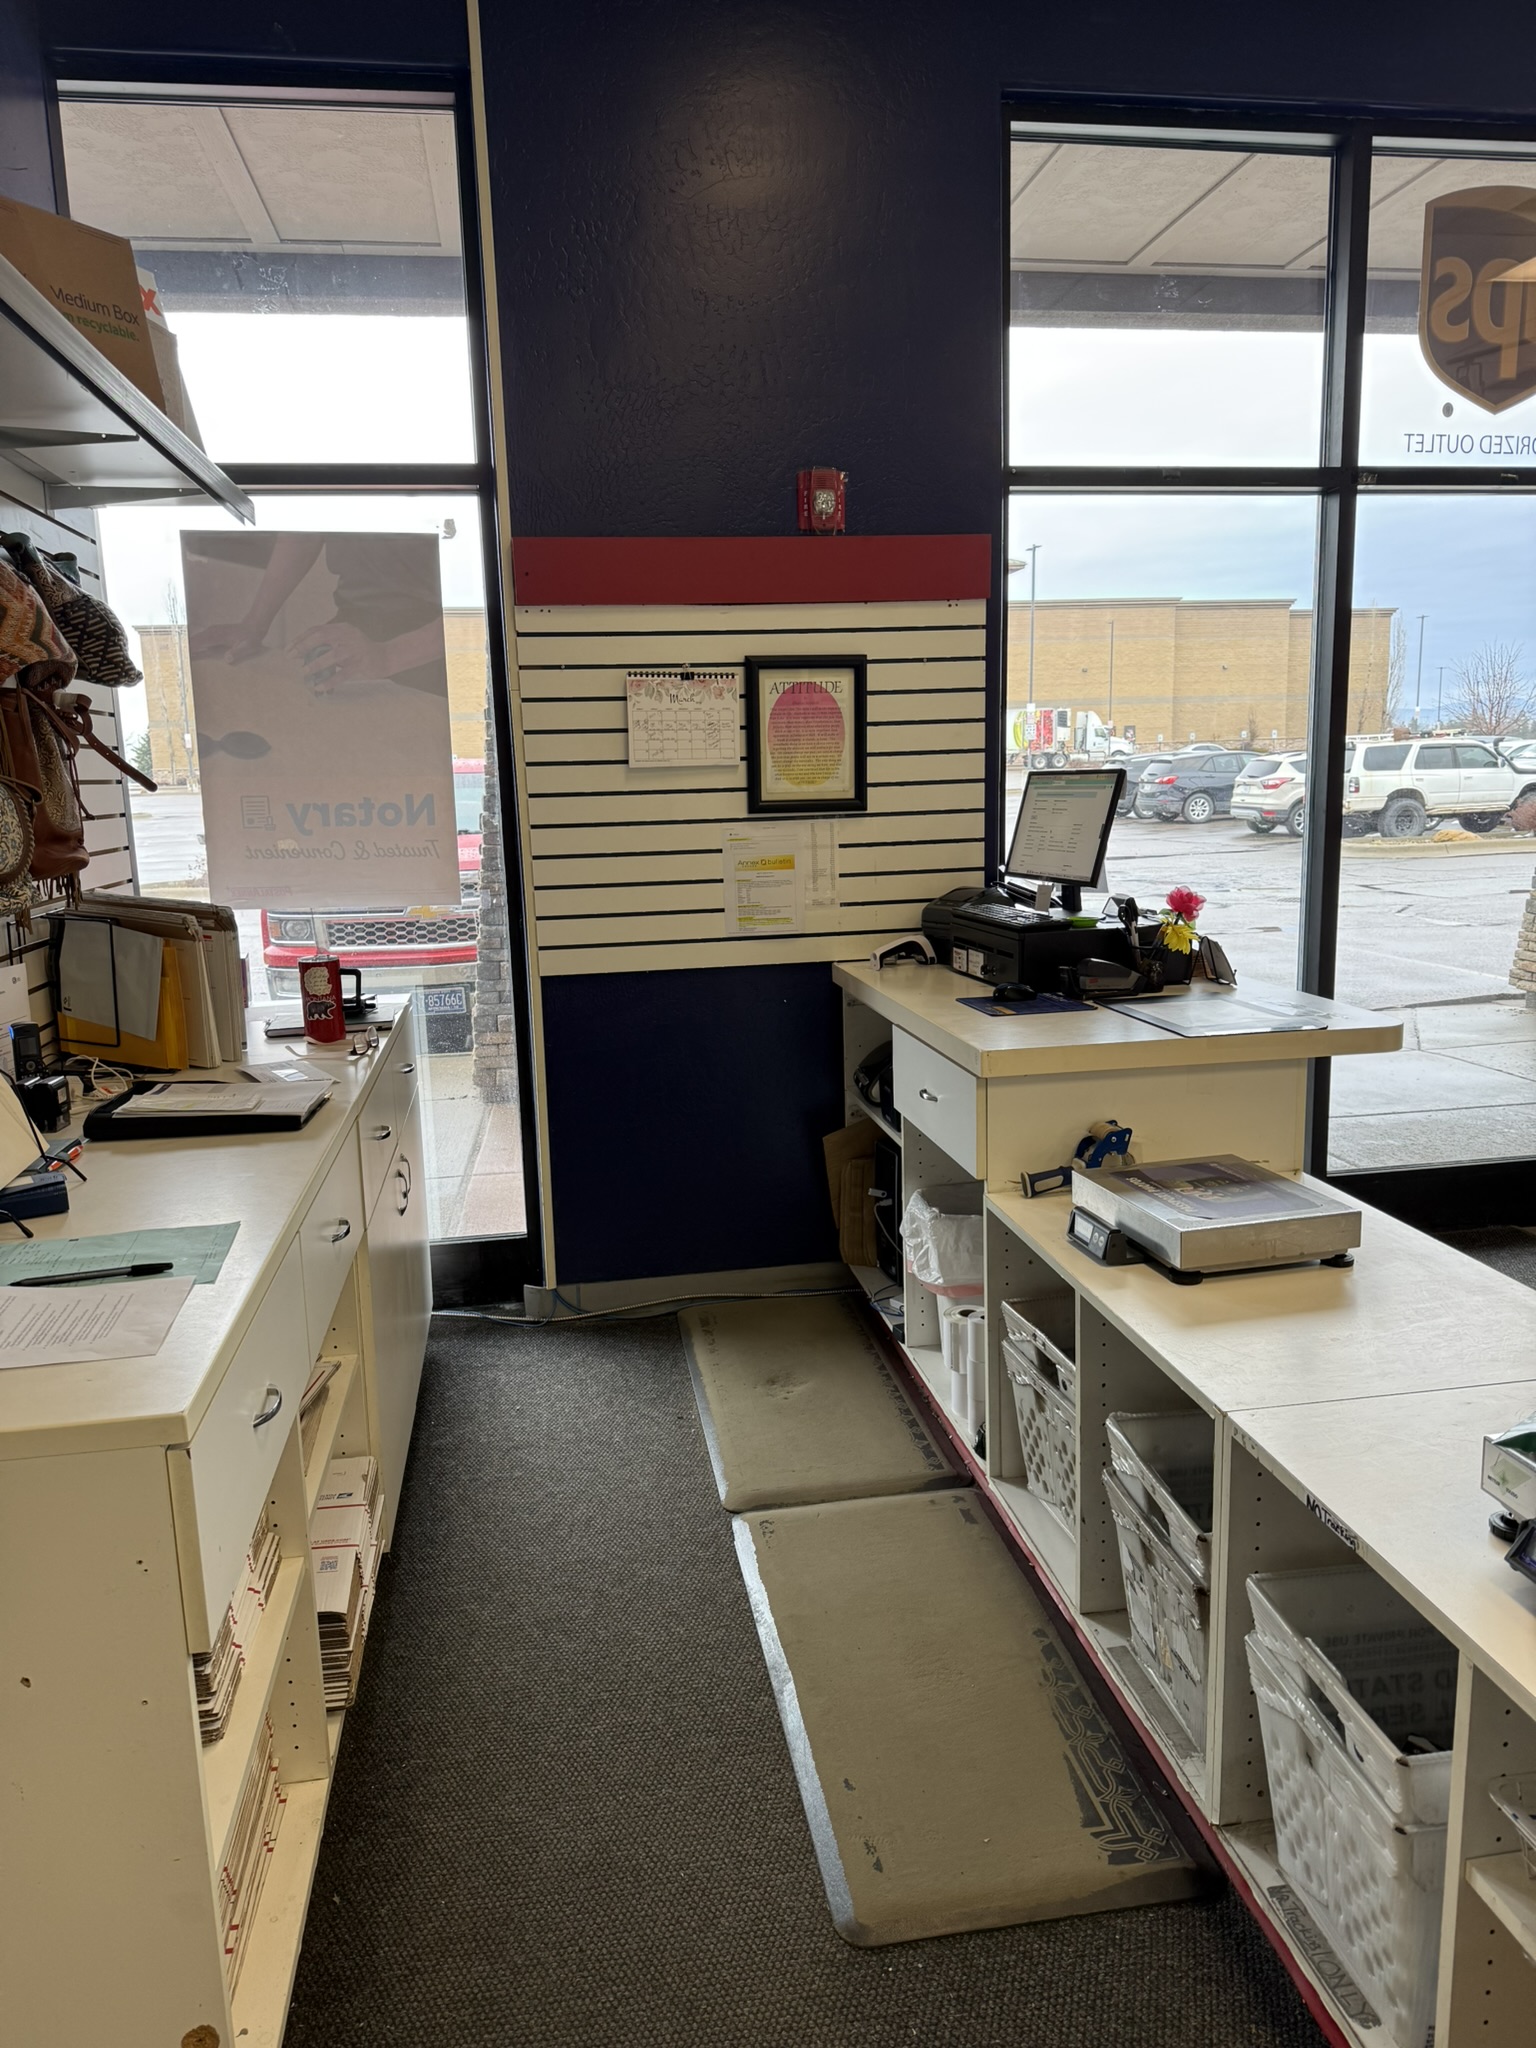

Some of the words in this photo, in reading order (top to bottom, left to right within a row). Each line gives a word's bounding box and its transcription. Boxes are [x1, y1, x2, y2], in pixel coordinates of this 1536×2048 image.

[113, 304, 140, 326] Box
[77, 315, 140, 341] recyclable.
[769, 680, 843, 695] ATTITUDE
[669, 693, 696, 705] March
[737, 858, 760, 866] Annex
[767, 858, 792, 866] bulletin
